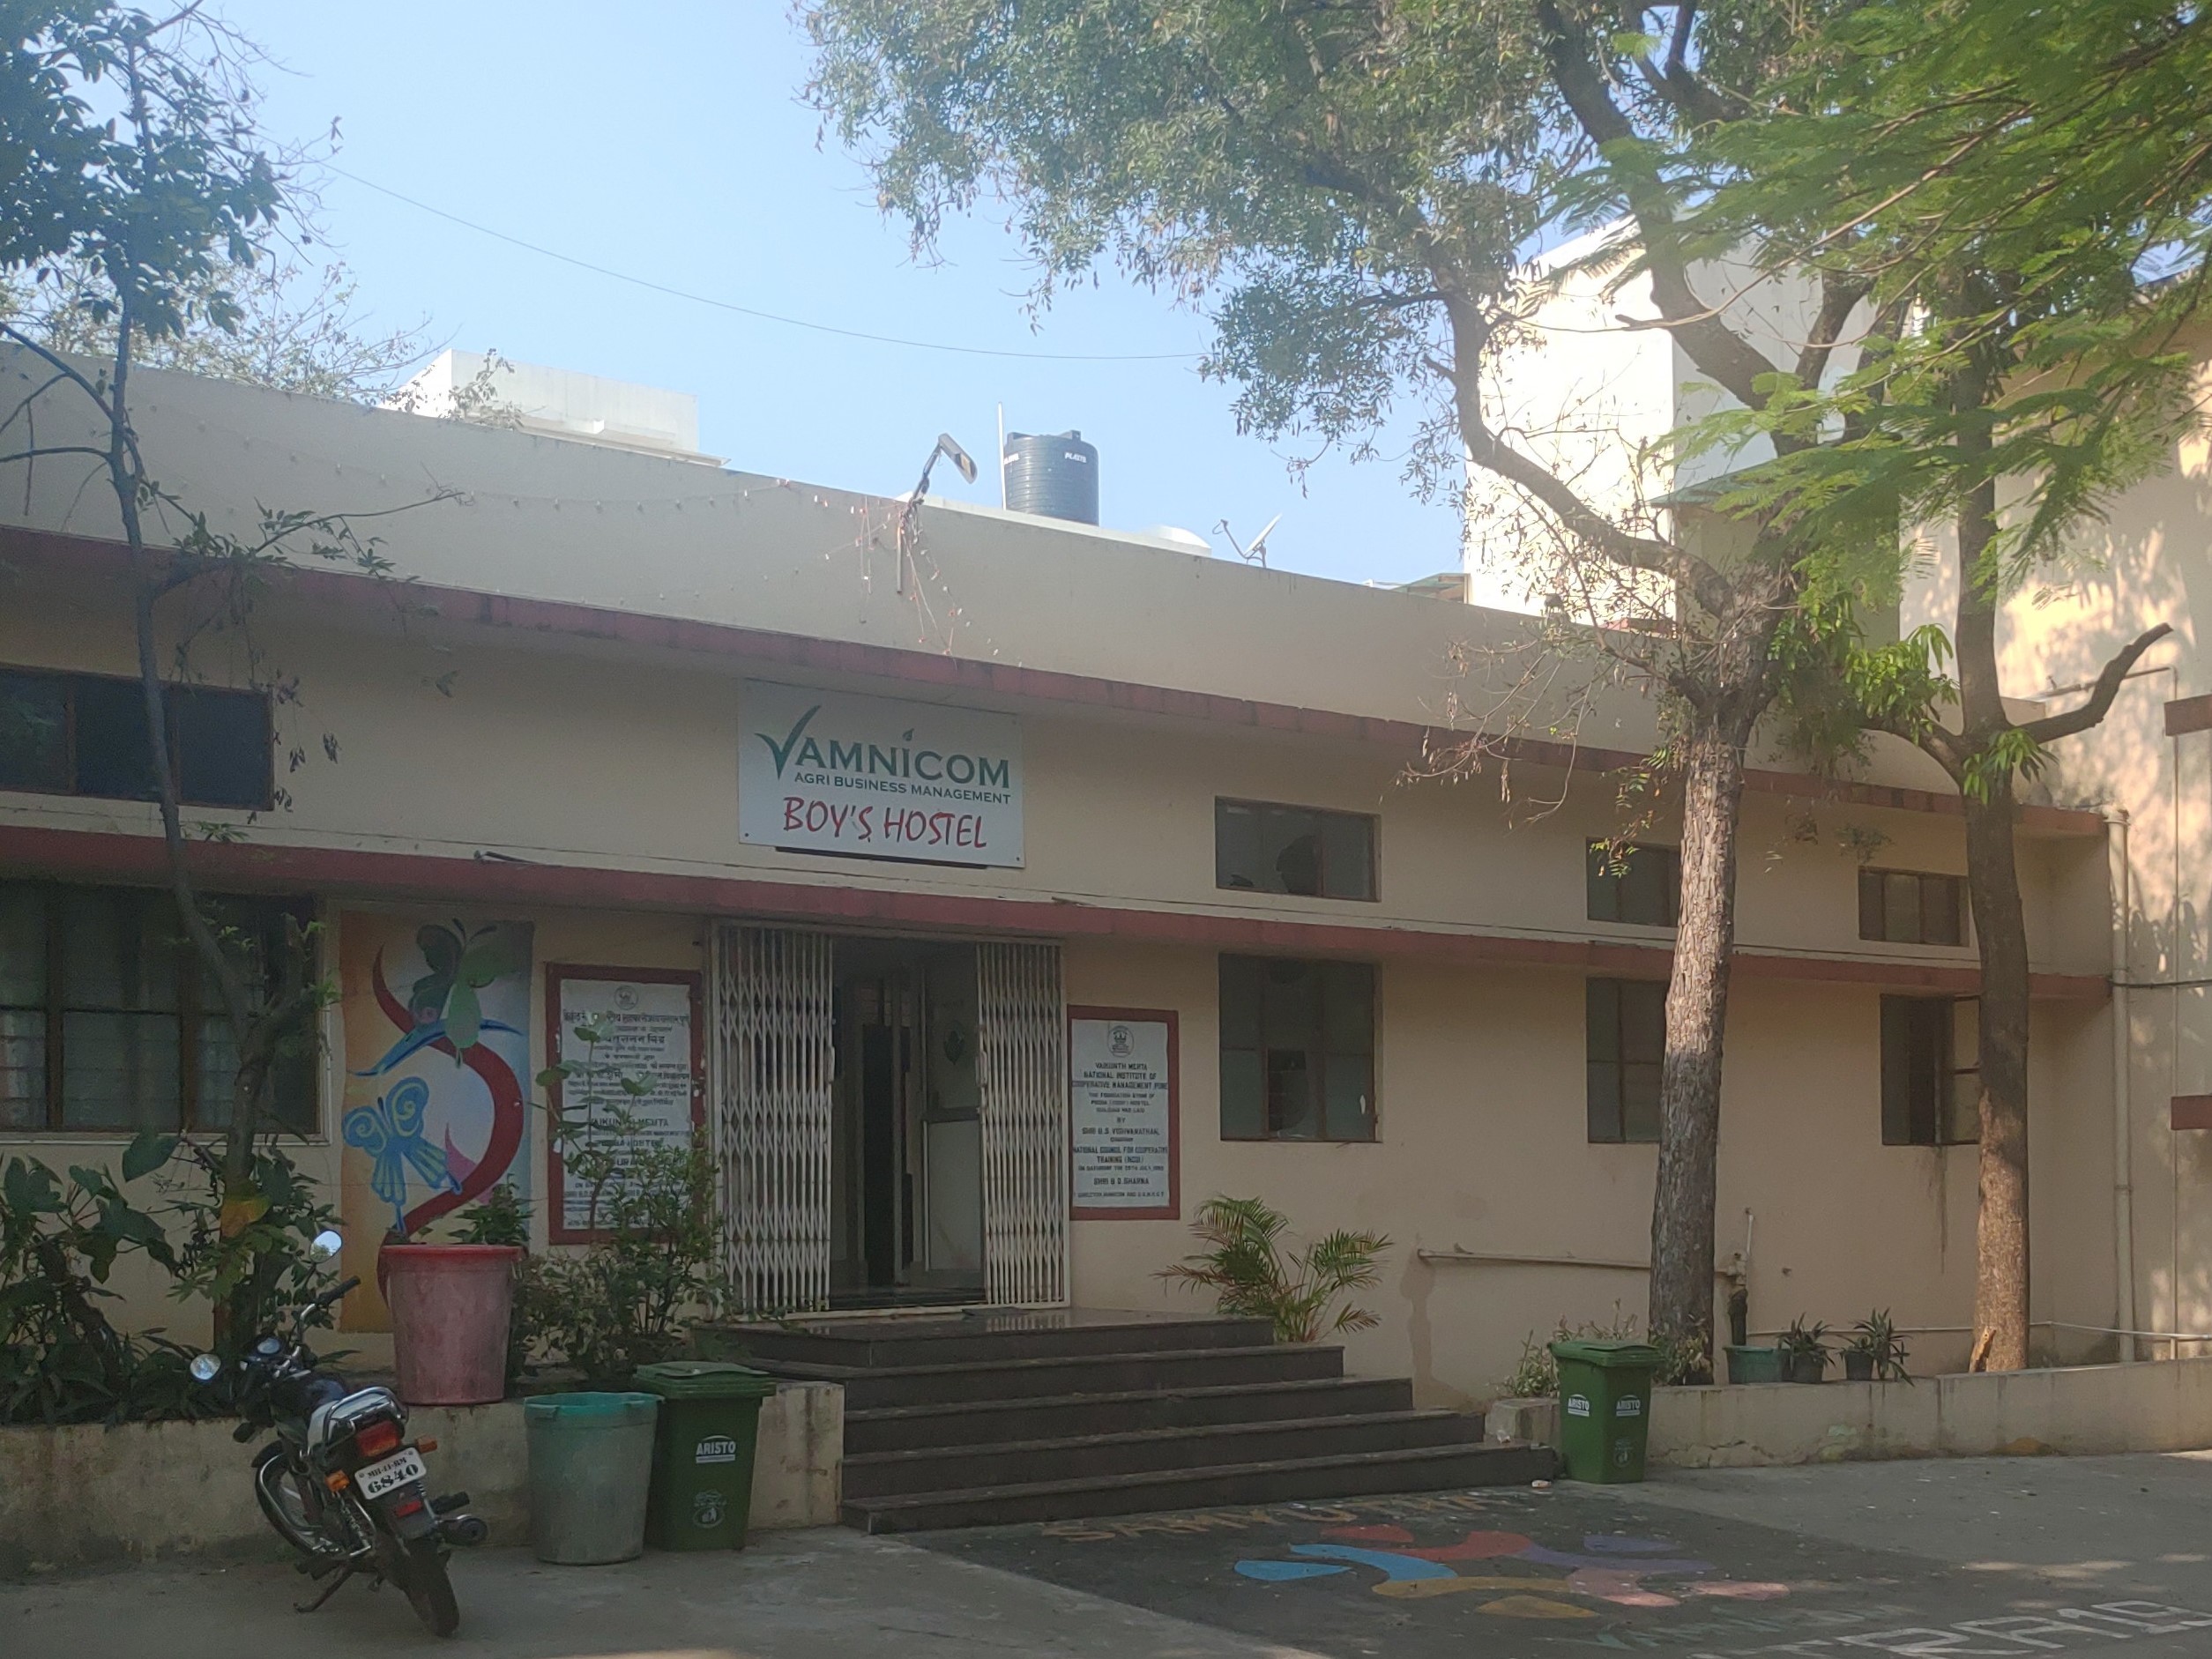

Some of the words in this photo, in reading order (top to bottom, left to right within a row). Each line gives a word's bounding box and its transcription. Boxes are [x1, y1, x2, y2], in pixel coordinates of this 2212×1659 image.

[755, 705, 1010, 789] VAMNICOM
[794, 771, 830, 785] AGRI
[834, 776, 907, 793] BUSINESS
[912, 784, 1011, 805] MANAGEMENT
[784, 796, 874, 843] BOY'S
[883, 807, 987, 848] HOSTEL
[1568, 1398, 1590, 1410] ARISTO
[696, 1440, 737, 1455] ARISTO
[368, 1464, 419, 1492] 6840
